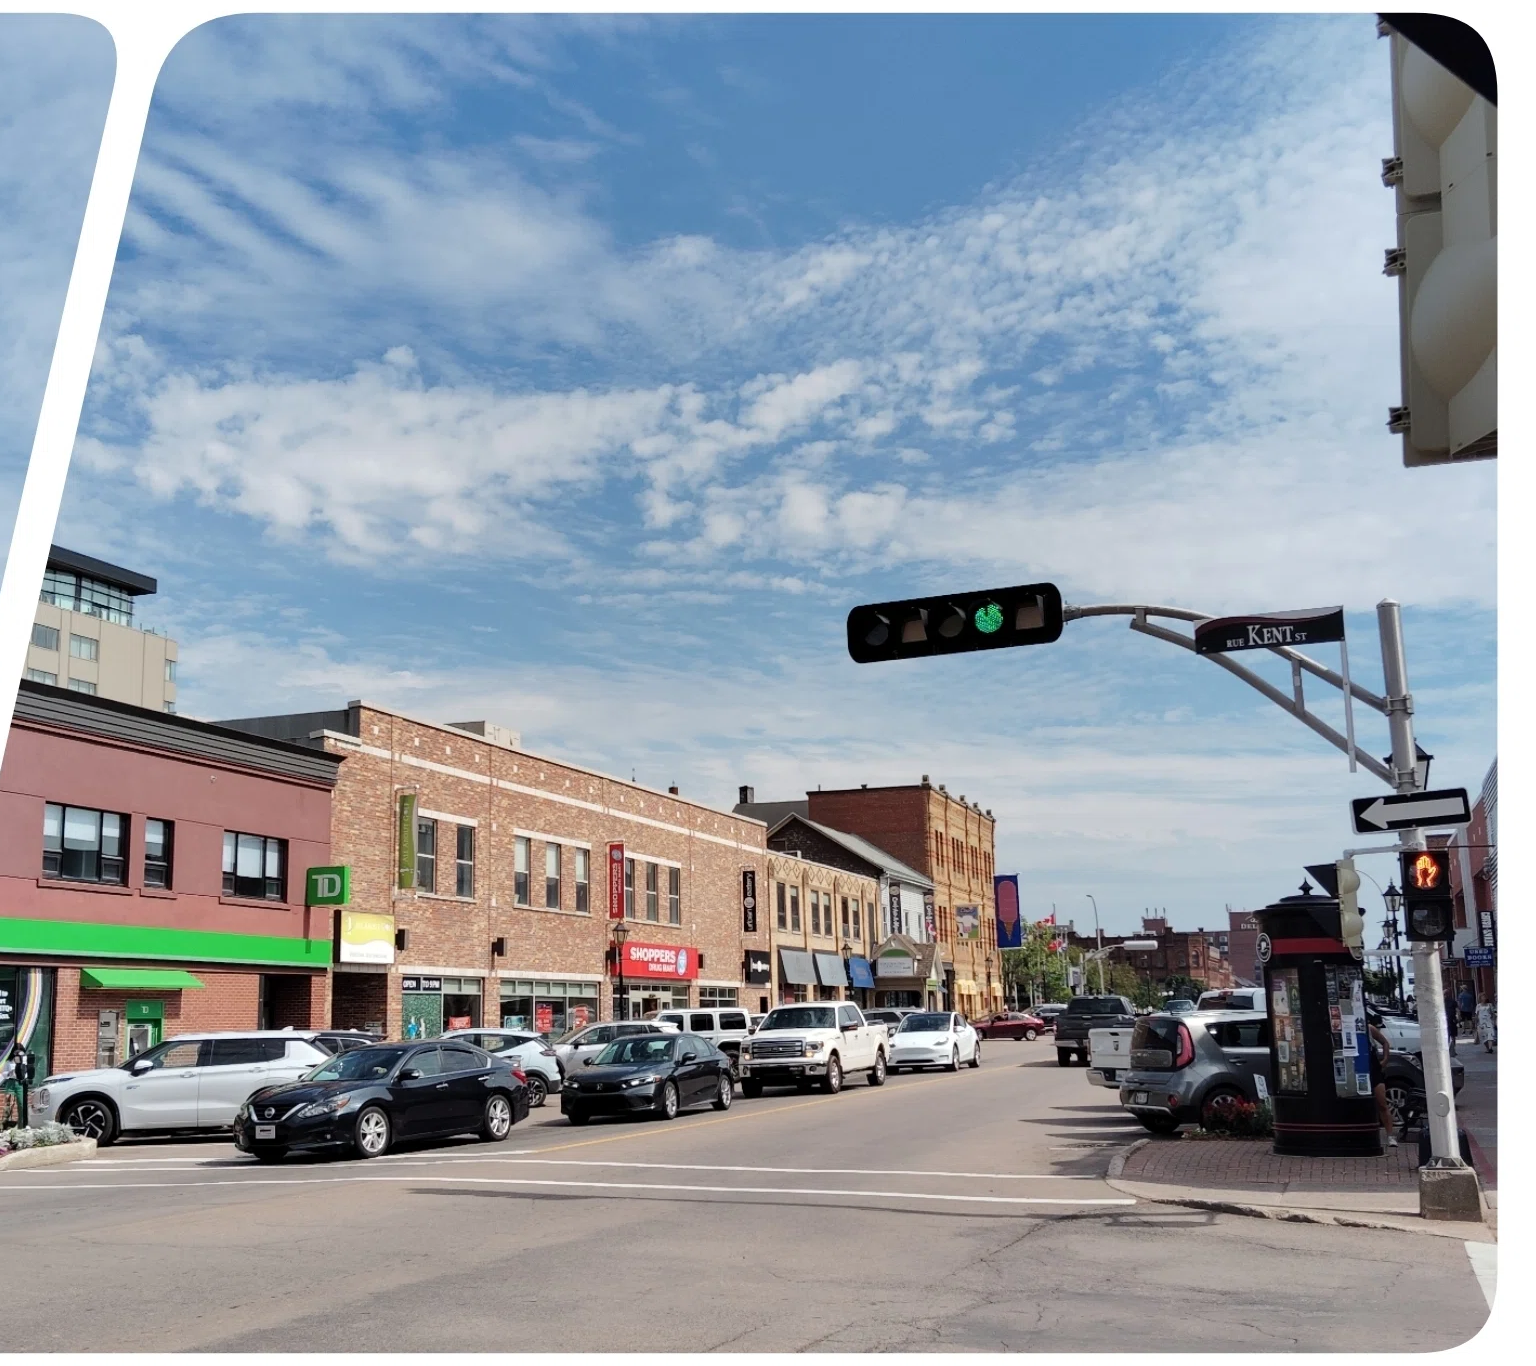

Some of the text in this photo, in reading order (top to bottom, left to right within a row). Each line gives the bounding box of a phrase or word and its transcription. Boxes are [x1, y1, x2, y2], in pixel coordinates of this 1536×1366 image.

[1226, 625, 1307, 647] RUE KENT ST
[311, 873, 342, 897] TD
[629, 946, 676, 963] SHOPPERS
[648, 963, 675, 972] DRUG MART
[403, 980, 416, 988] OPEN
